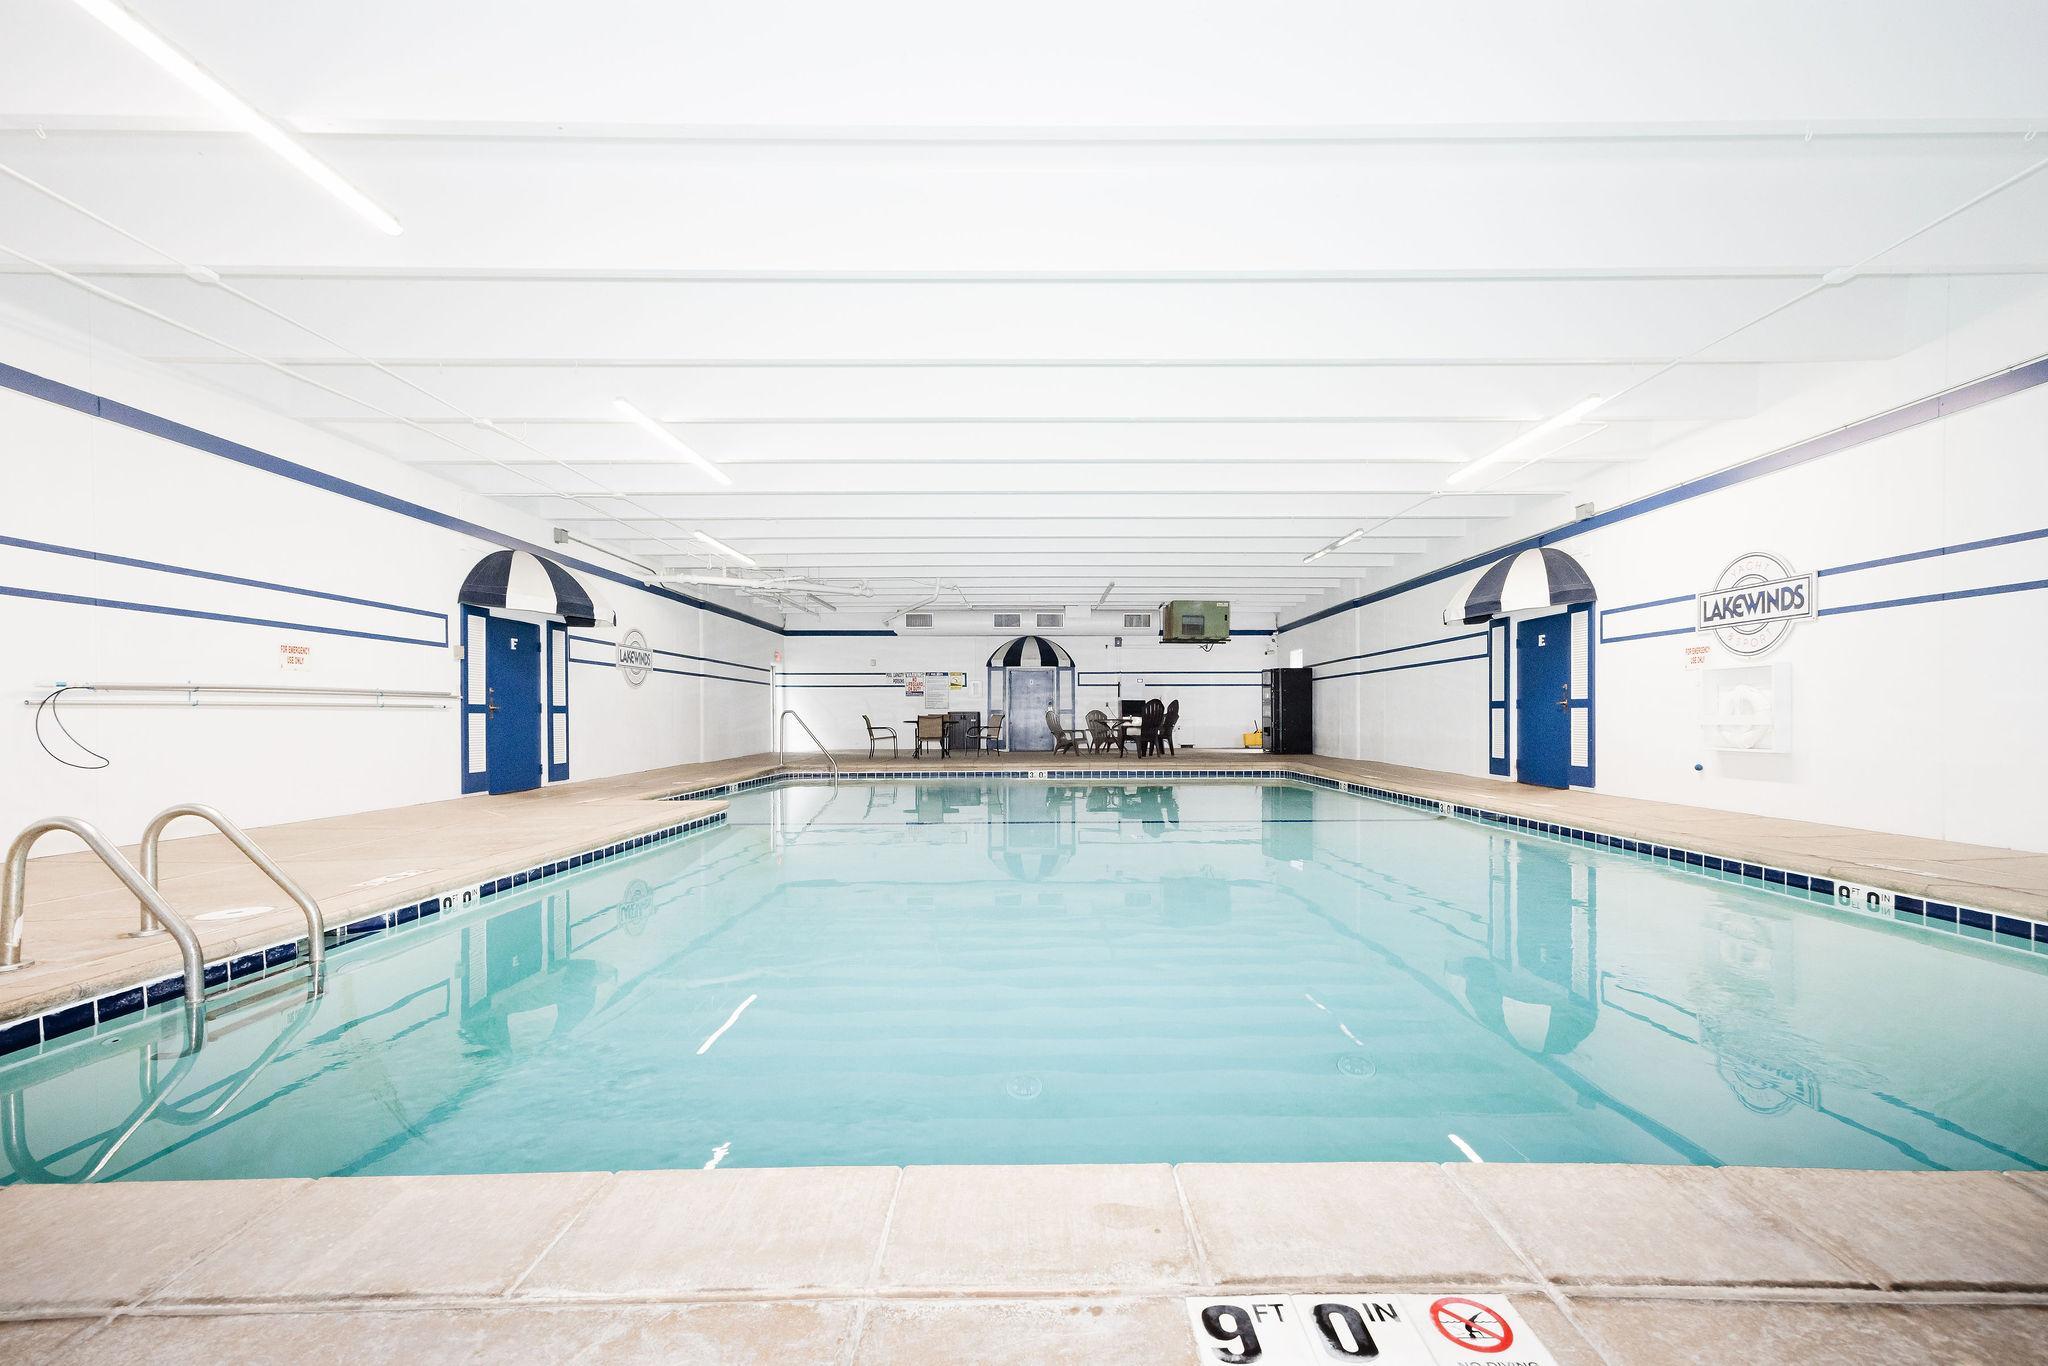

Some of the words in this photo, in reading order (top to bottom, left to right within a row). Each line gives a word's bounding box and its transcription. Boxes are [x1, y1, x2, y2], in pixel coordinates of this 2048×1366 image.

[1703, 584, 1805, 622] LAKEWINDS
[510, 637, 519, 650] E
[1538, 634, 1546, 647] E
[619, 648, 651, 666] LAKEWINDS
[1881, 893, 1891, 903] IN
[1201, 1304, 1263, 1364] 9
[1252, 1303, 1285, 1323] FT
[1312, 1302, 1380, 1363] 0
[1362, 1302, 1402, 1323] IN
